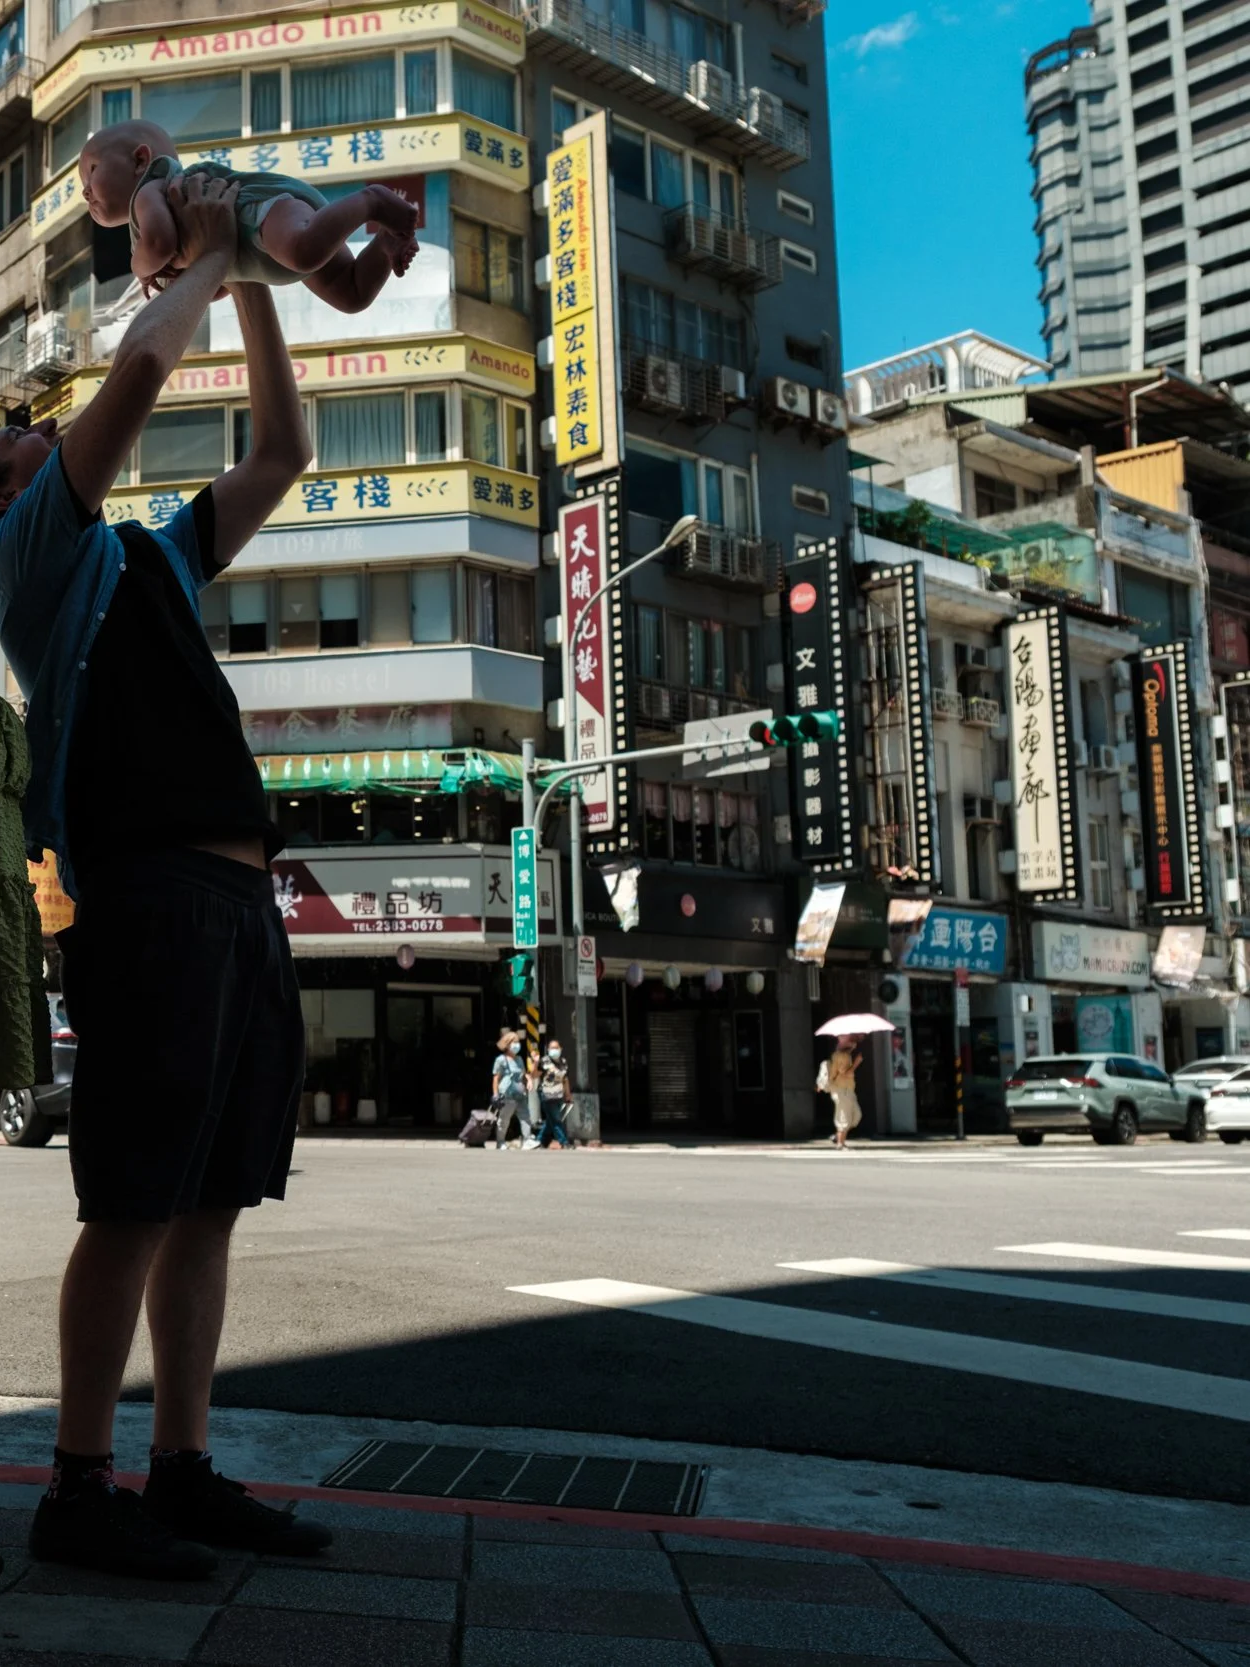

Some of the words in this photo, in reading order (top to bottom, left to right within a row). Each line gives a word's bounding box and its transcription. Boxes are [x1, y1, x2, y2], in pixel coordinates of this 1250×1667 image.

[150, 19, 304, 61] Amando
[324, 11, 382, 41] Inn
[463, 7, 522, 46] Amando
[464, 127, 524, 169] 愛滿多
[576, 178, 591, 243] Amando
[327, 350, 388, 378] Inn
[470, 348, 530, 380] Amando
[563, 323, 600, 451] 宏林素食
[473, 475, 534, 512] 愛滿多
[518, 844, 532, 909] 博愛路
[352, 890, 443, 916] 禮品坊
